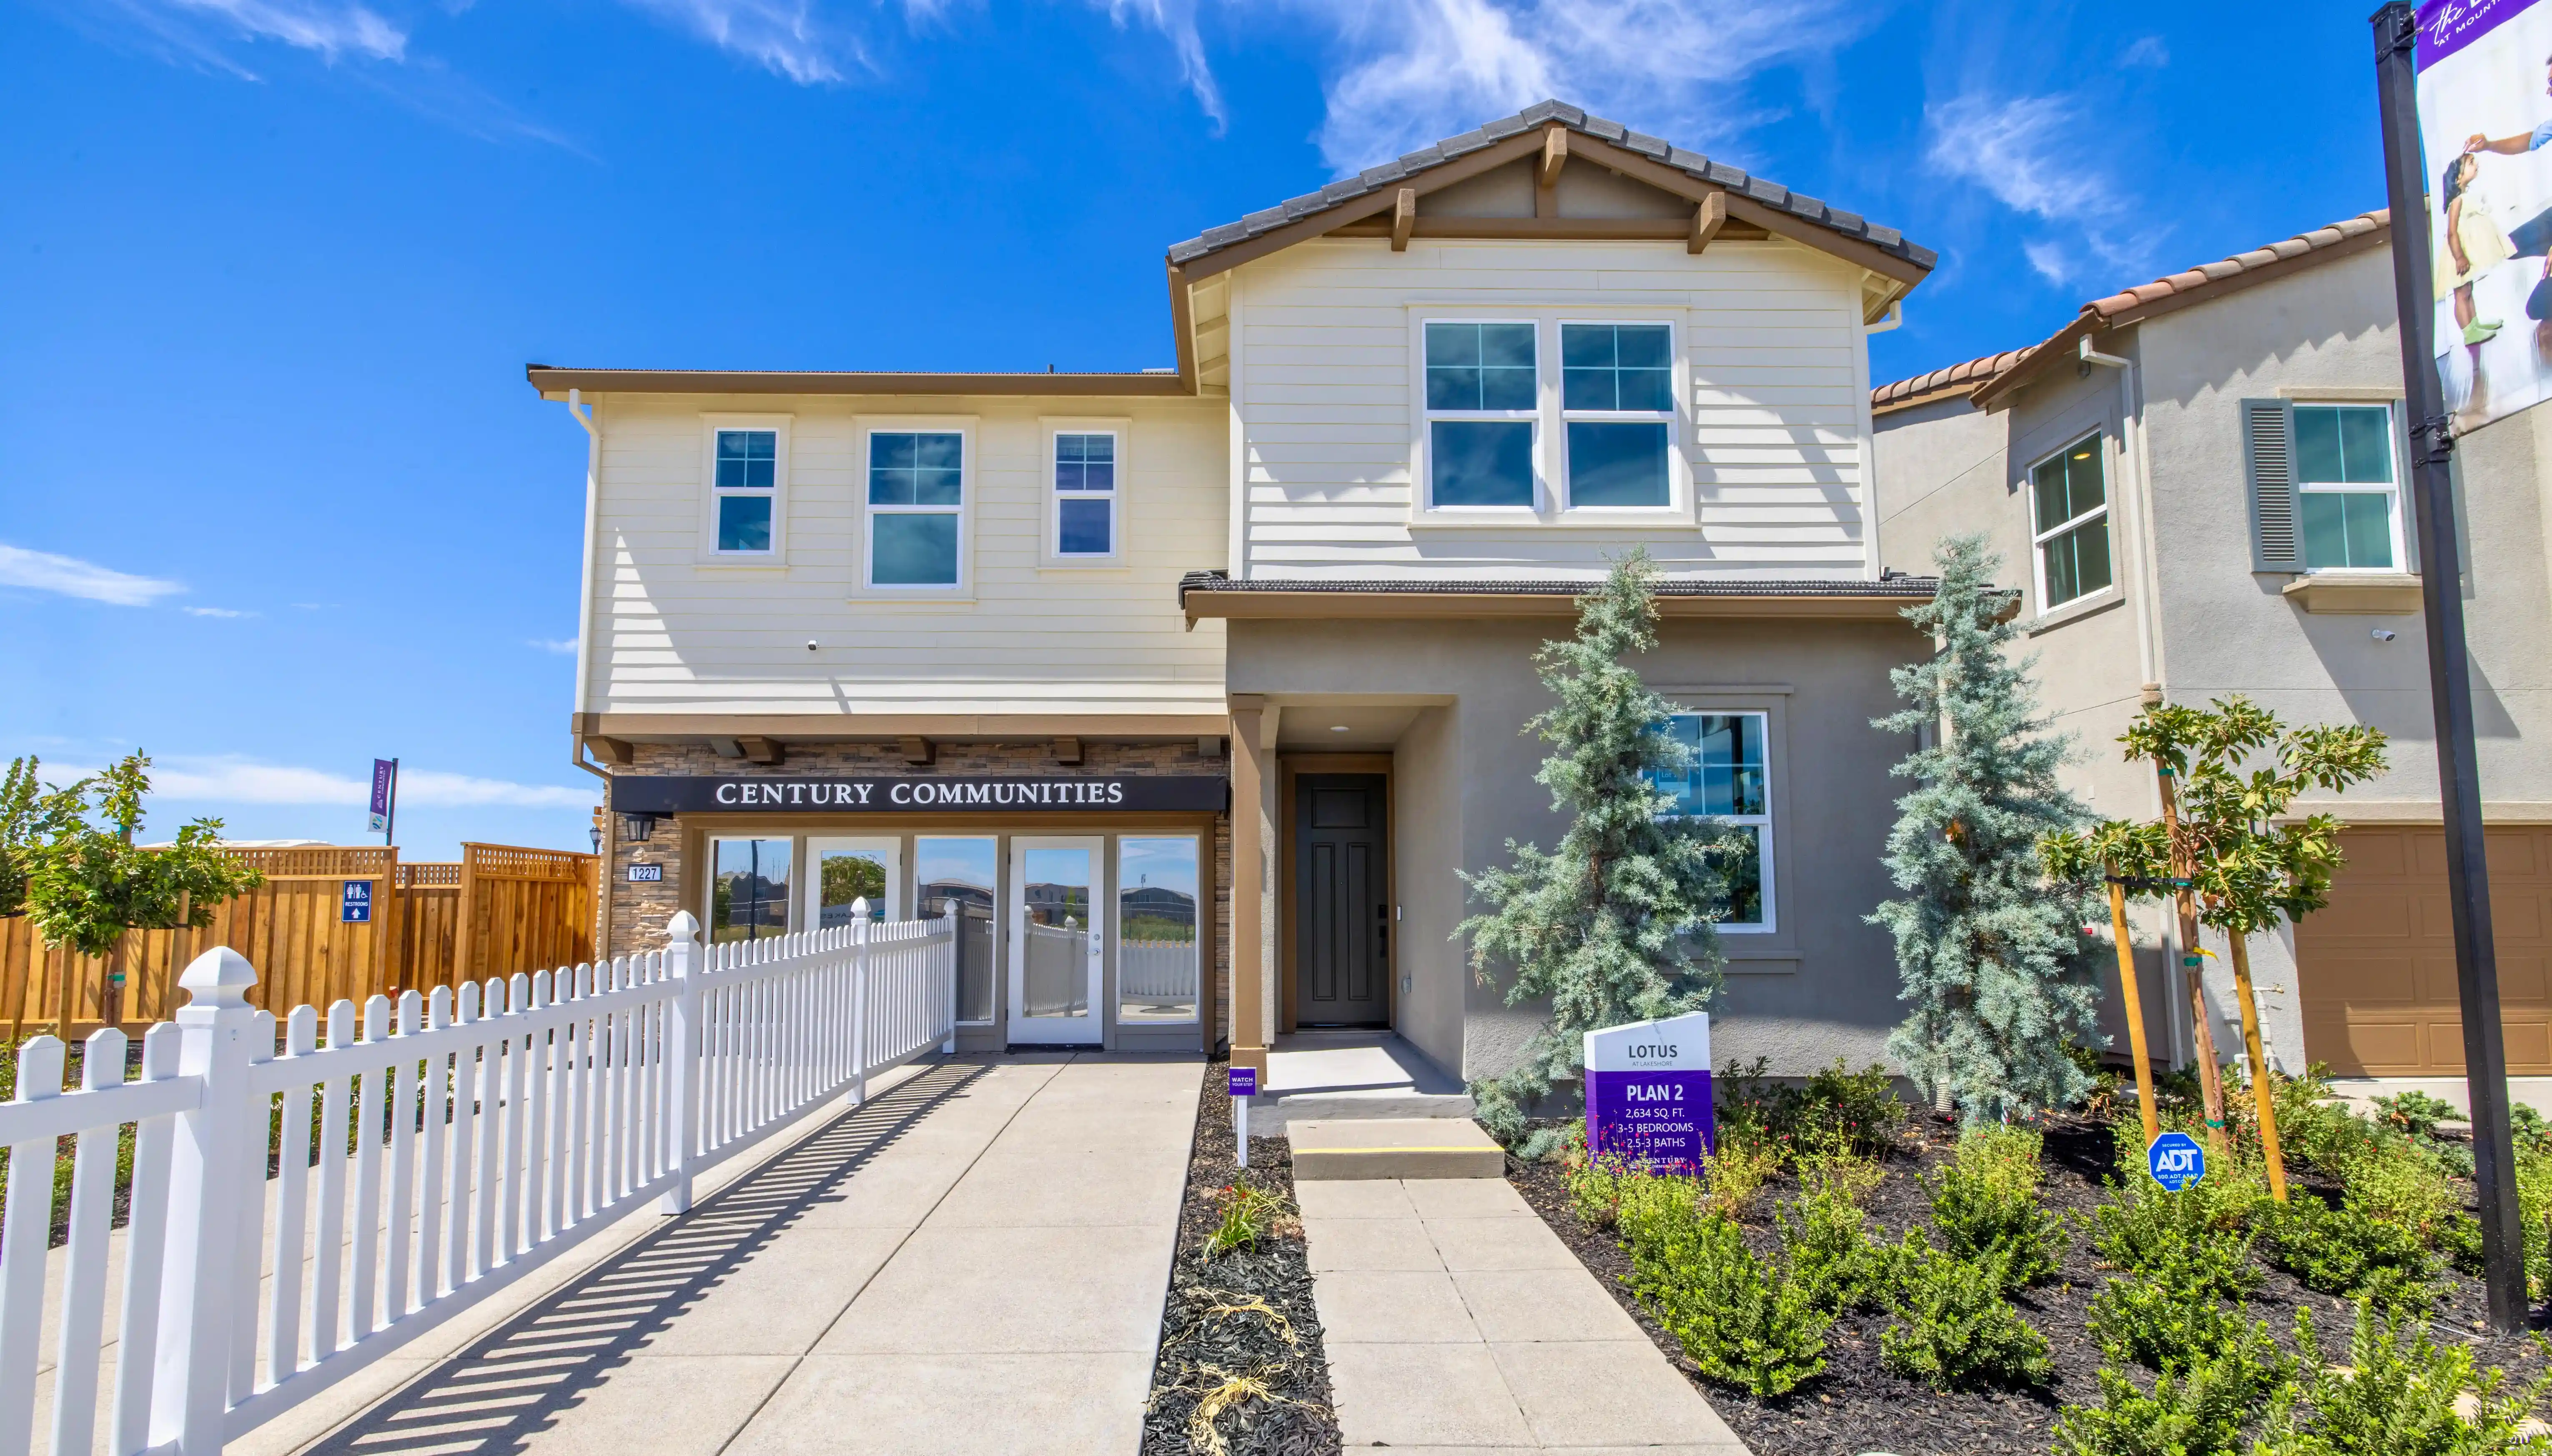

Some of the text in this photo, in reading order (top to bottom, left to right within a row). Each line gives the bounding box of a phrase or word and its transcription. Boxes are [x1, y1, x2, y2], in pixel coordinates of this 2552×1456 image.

[2429, 3, 2467, 45] the
[2438, 0, 2501, 47] AT MOUNT
[716, 783, 1123, 804] CENTURY COMMUNITIES
[633, 868, 657, 879] 1227
[1629, 1045, 1677, 1058] LOTUS
[1627, 1084, 1683, 1101] PLAN 2
[1626, 1108, 1685, 1119] 2,634 SQ. FT.
[1618, 1123, 1693, 1133] 3-5 BEDROOMS
[1627, 1138, 1685, 1148] 2.5-3 BATHS
[2156, 1149, 2198, 1172] ADT
